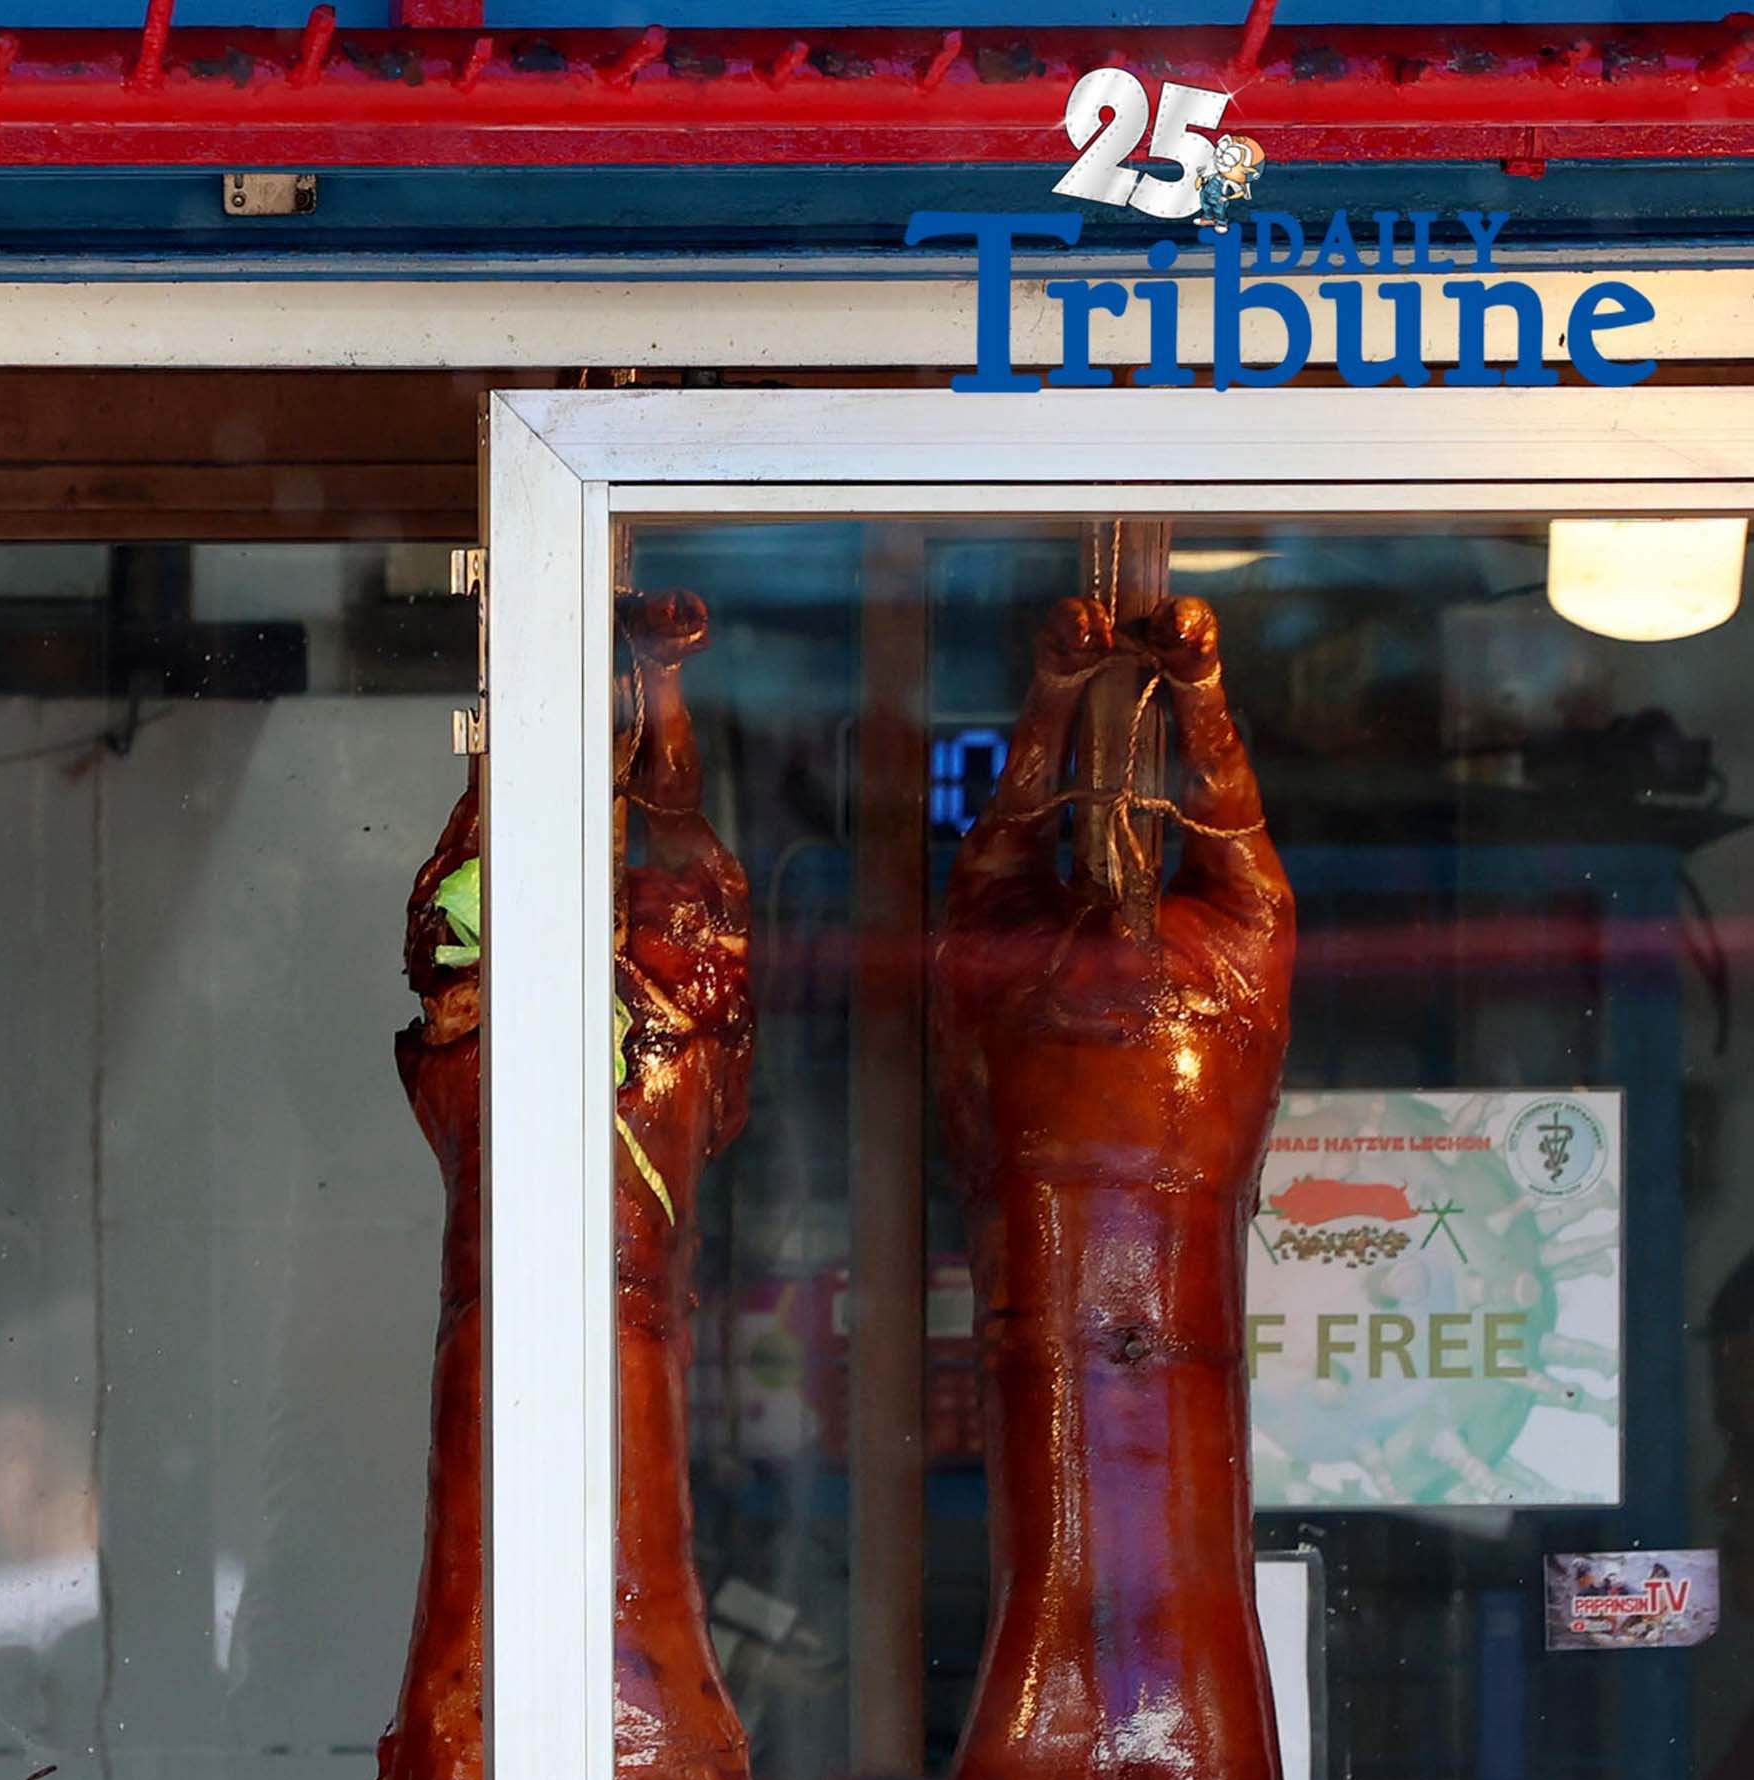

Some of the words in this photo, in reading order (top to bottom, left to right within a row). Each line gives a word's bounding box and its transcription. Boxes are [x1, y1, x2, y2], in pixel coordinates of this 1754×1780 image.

[1324, 1136, 1406, 1153] NATIVE
[1409, 1136, 1492, 1153] LECHON
[1315, 1312, 1530, 1380] FREE
[1643, 1580, 1690, 1613] TV
